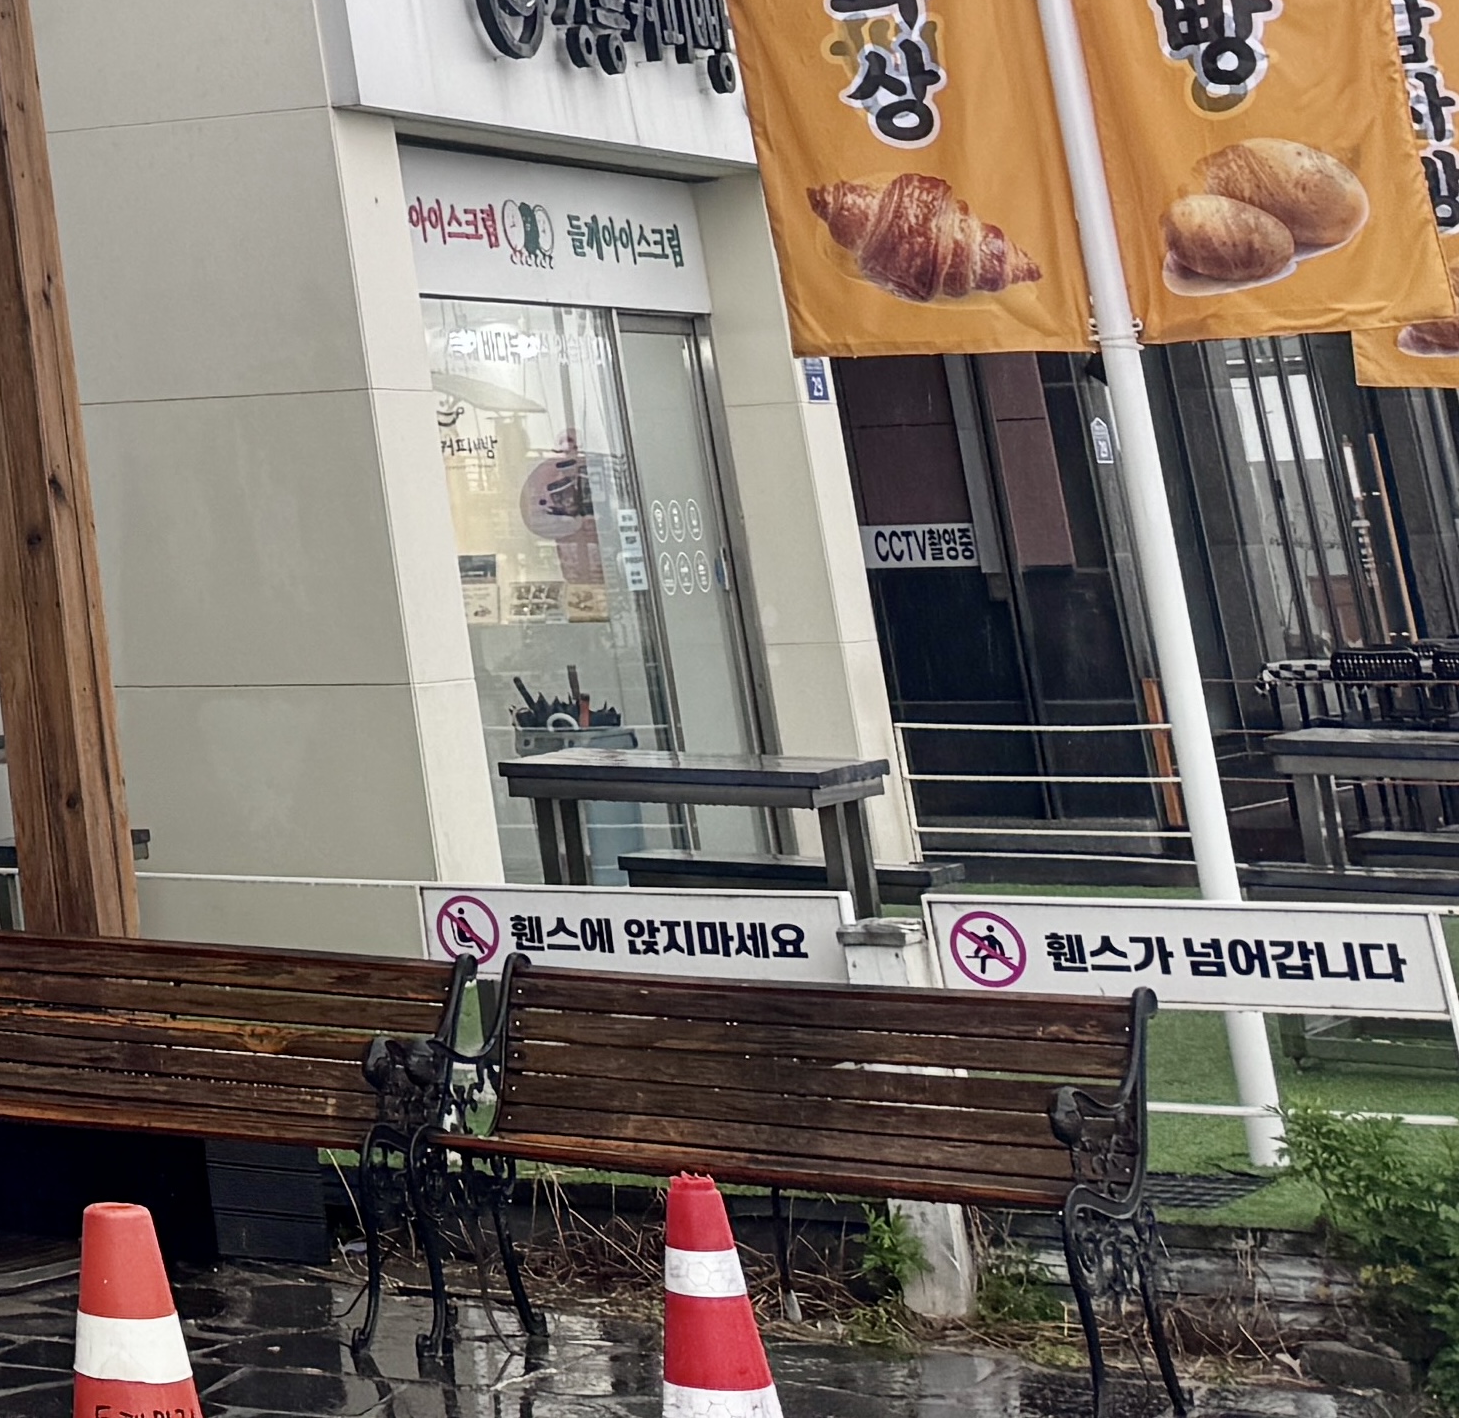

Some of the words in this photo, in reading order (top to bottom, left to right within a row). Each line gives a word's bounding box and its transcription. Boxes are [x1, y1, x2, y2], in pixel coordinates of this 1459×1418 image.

[409, 196, 500, 250] 아이스크림
[567, 213, 686, 269] 들깨아이스크림
[873, 527, 975, 562] CCTV촬영중
[509, 914, 615, 954] 휀스에
[623, 918, 809, 959] 앉지마세요
[1044, 932, 1175, 975] 휀스가
[1182, 937, 1407, 983] 넘어갑니다
